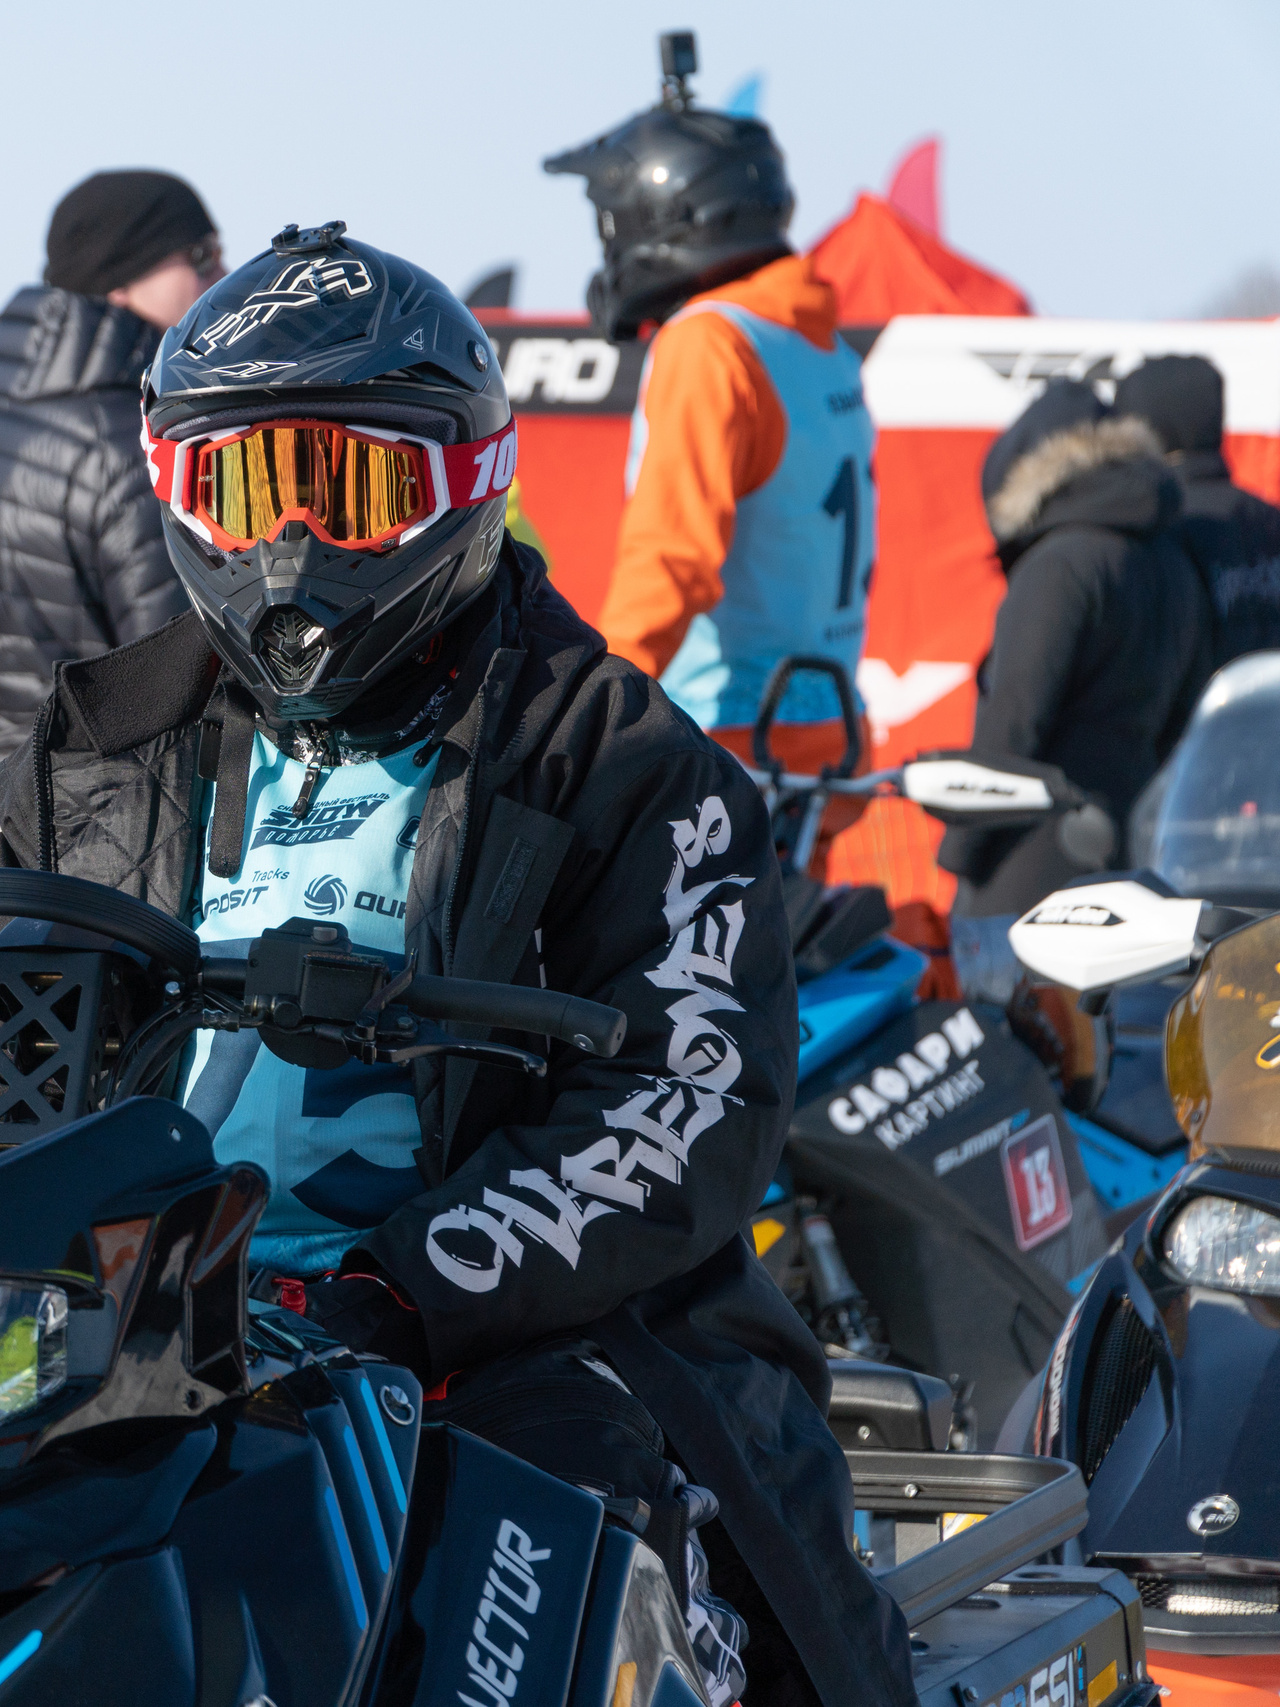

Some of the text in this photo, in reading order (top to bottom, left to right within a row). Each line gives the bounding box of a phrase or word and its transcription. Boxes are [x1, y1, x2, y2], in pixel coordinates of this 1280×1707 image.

[489, 338, 620, 404] RO
[469, 420, 518, 500] 10
[252, 868, 290, 882] Tracks
